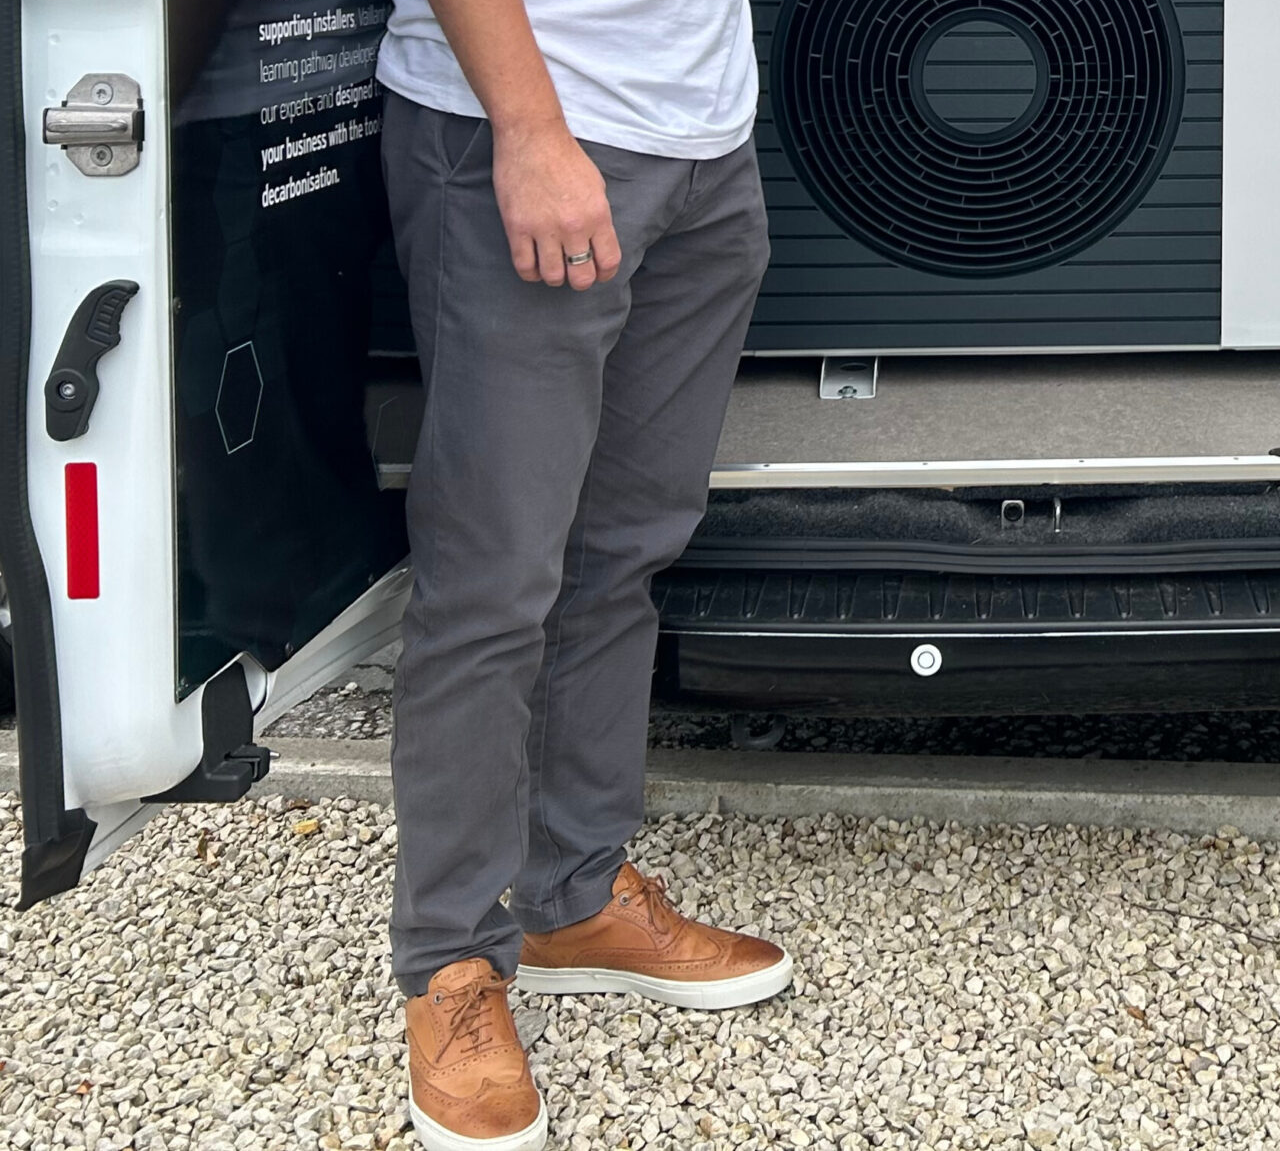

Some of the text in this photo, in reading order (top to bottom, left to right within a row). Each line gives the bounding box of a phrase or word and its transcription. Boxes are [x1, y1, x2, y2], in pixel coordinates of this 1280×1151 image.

[259, 13, 312, 45] supporting
[260, 58, 298, 83] learning
[301, 50, 337, 81] pathway
[260, 104, 277, 125] our
[280, 92, 315, 124] experts,
[317, 87, 333, 114] and
[335, 78, 372, 108] designed
[262, 141, 284, 171] your
[286, 132, 326, 158] business
[328, 122, 348, 146] with
[349, 118, 363, 140] the
[262, 166, 339, 208] decarbonisation.
